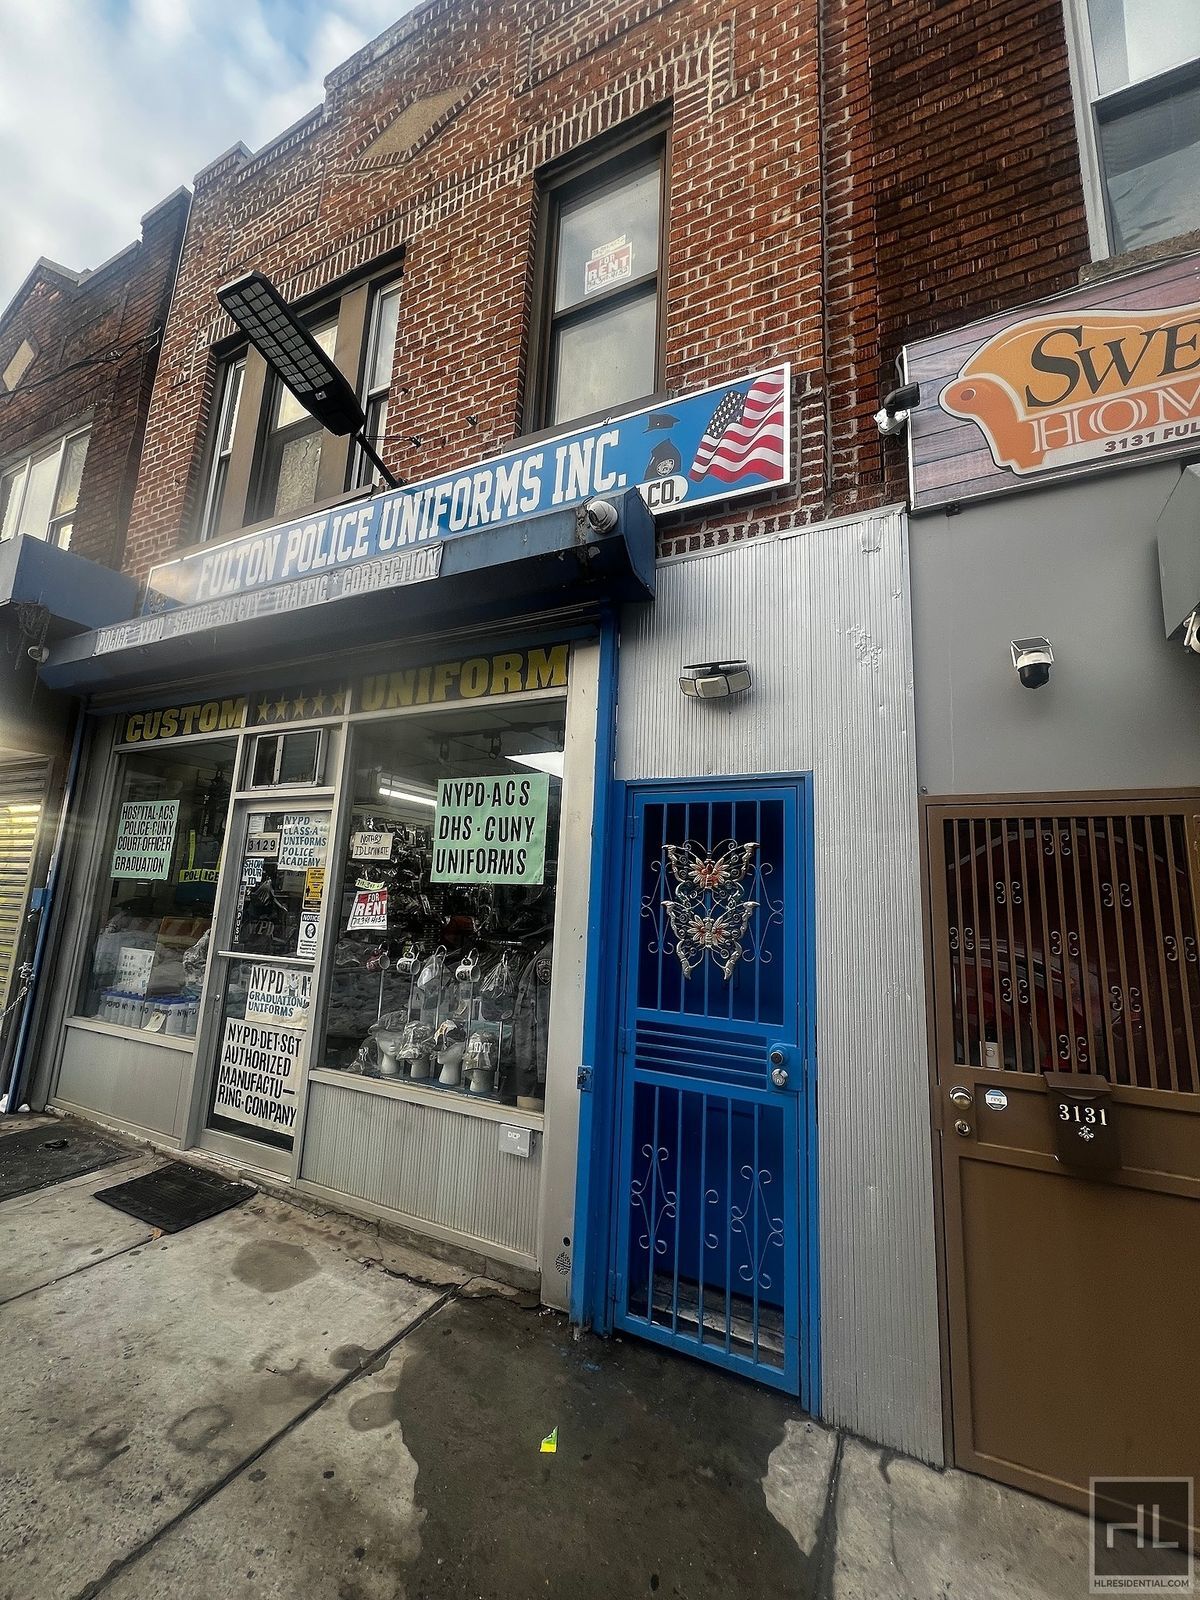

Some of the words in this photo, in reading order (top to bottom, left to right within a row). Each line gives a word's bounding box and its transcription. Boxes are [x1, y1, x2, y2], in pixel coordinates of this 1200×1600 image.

[588, 254, 630, 282] RENT
[599, 253, 617, 267] FOR
[1104, 431, 1156, 453] 3131
[648, 479, 680, 507] CO.
[197, 534, 282, 601] FULTON
[281, 505, 376, 577] POLICE
[378, 452, 544, 551] UNIFORMS
[551, 429, 627, 506] INC.
[96, 624, 131, 652] POLICE
[218, 592, 260, 623] SAFETY
[274, 574, 329, 611] TRAFFIC
[341, 547, 439, 595] CORRECTION
[125, 696, 247, 743] CUSTOM
[361, 644, 569, 711] UNIFORM
[284, 815, 310, 826] NYPD
[439, 815, 473, 841] DHS
[484, 816, 536, 843] CUNY
[248, 839, 276, 851] 3129
[283, 837, 327, 847] UNIFORMS
[282, 847, 314, 857] POLICE
[115, 856, 165, 873] GRADUATION
[244, 859, 264, 868] SHOW
[279, 856, 321, 868] ACADEMY
[435, 848, 527, 875] UNIFORMS
[183, 870, 219, 881] POLICE
[244, 868, 262, 877] YOUR
[367, 892, 380, 902] FOR
[354, 900, 387, 916] RENT
[250, 966, 285, 995] NYPD
[248, 1002, 294, 1018] UNIFORMS
[224, 1044, 291, 1077] AUTHORIZED
[1059, 1103, 1108, 1126] 3131
